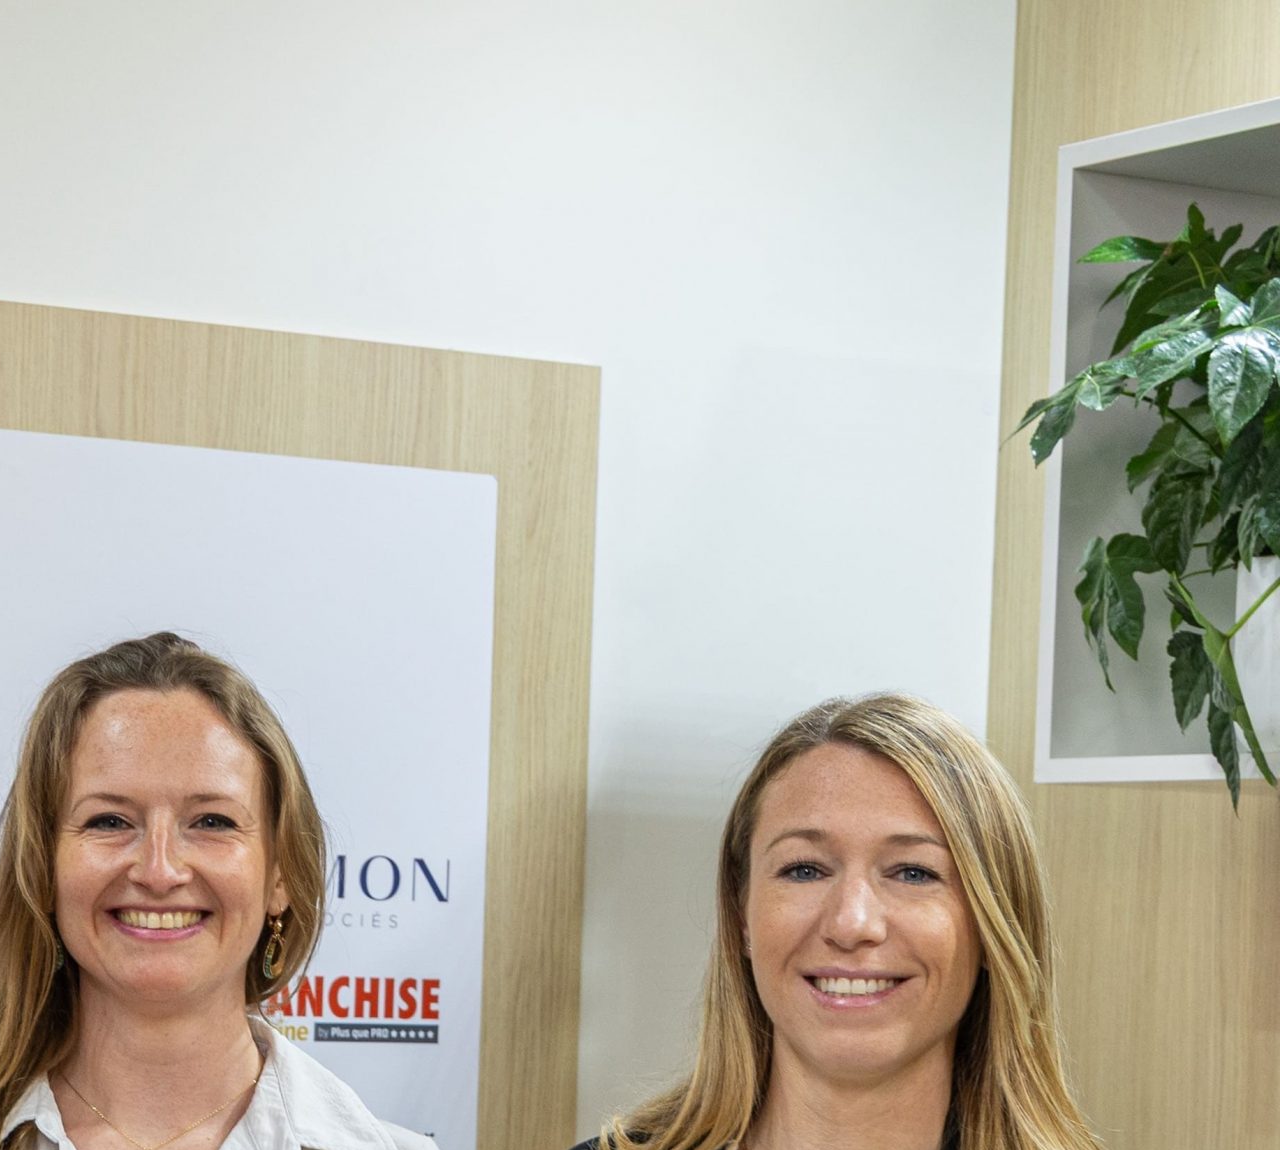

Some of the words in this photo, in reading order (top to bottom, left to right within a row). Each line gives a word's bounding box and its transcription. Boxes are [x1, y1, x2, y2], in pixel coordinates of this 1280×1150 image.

[331, 1028, 350, 1039] Plus
[352, 1030, 369, 1040] que
[371, 1029, 389, 1039] PRO
